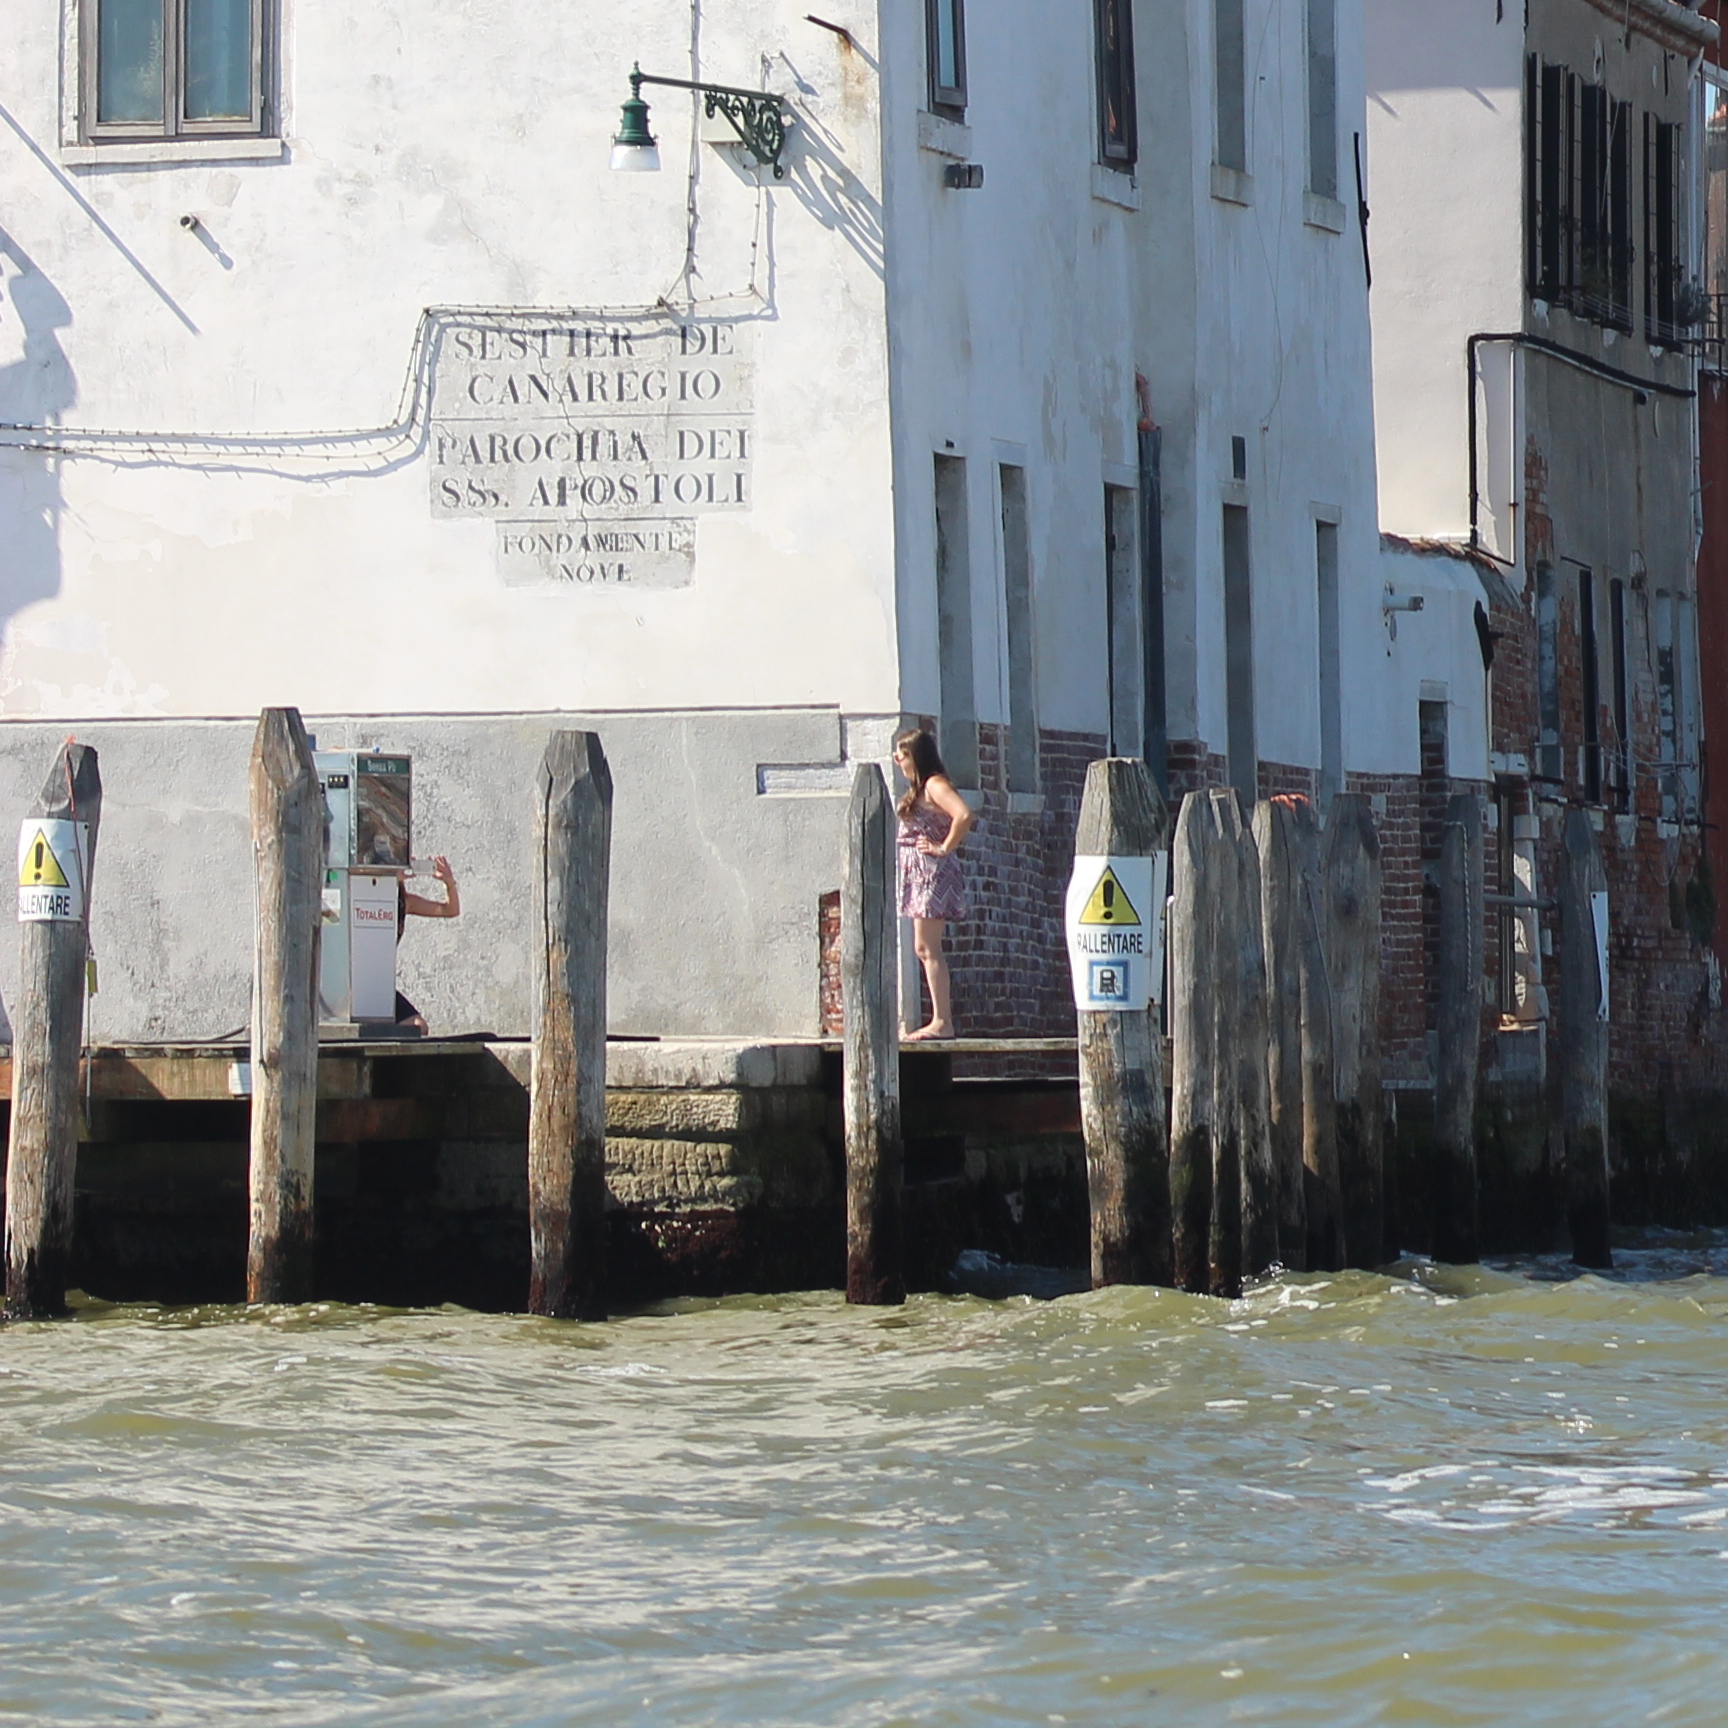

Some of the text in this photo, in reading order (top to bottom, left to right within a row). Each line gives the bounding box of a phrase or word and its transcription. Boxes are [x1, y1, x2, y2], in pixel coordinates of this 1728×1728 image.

[454, 324, 735, 361] SESTIER DE
[467, 369, 722, 405] CANAREGIO
[437, 428, 749, 466] PAROCHIA DEI
[440, 473, 746, 509] SS. APOSTOLI
[502, 531, 683, 555] FONDAMENTE
[560, 562, 632, 583] NOVE
[1077, 932, 1144, 955] RALLENTARE
